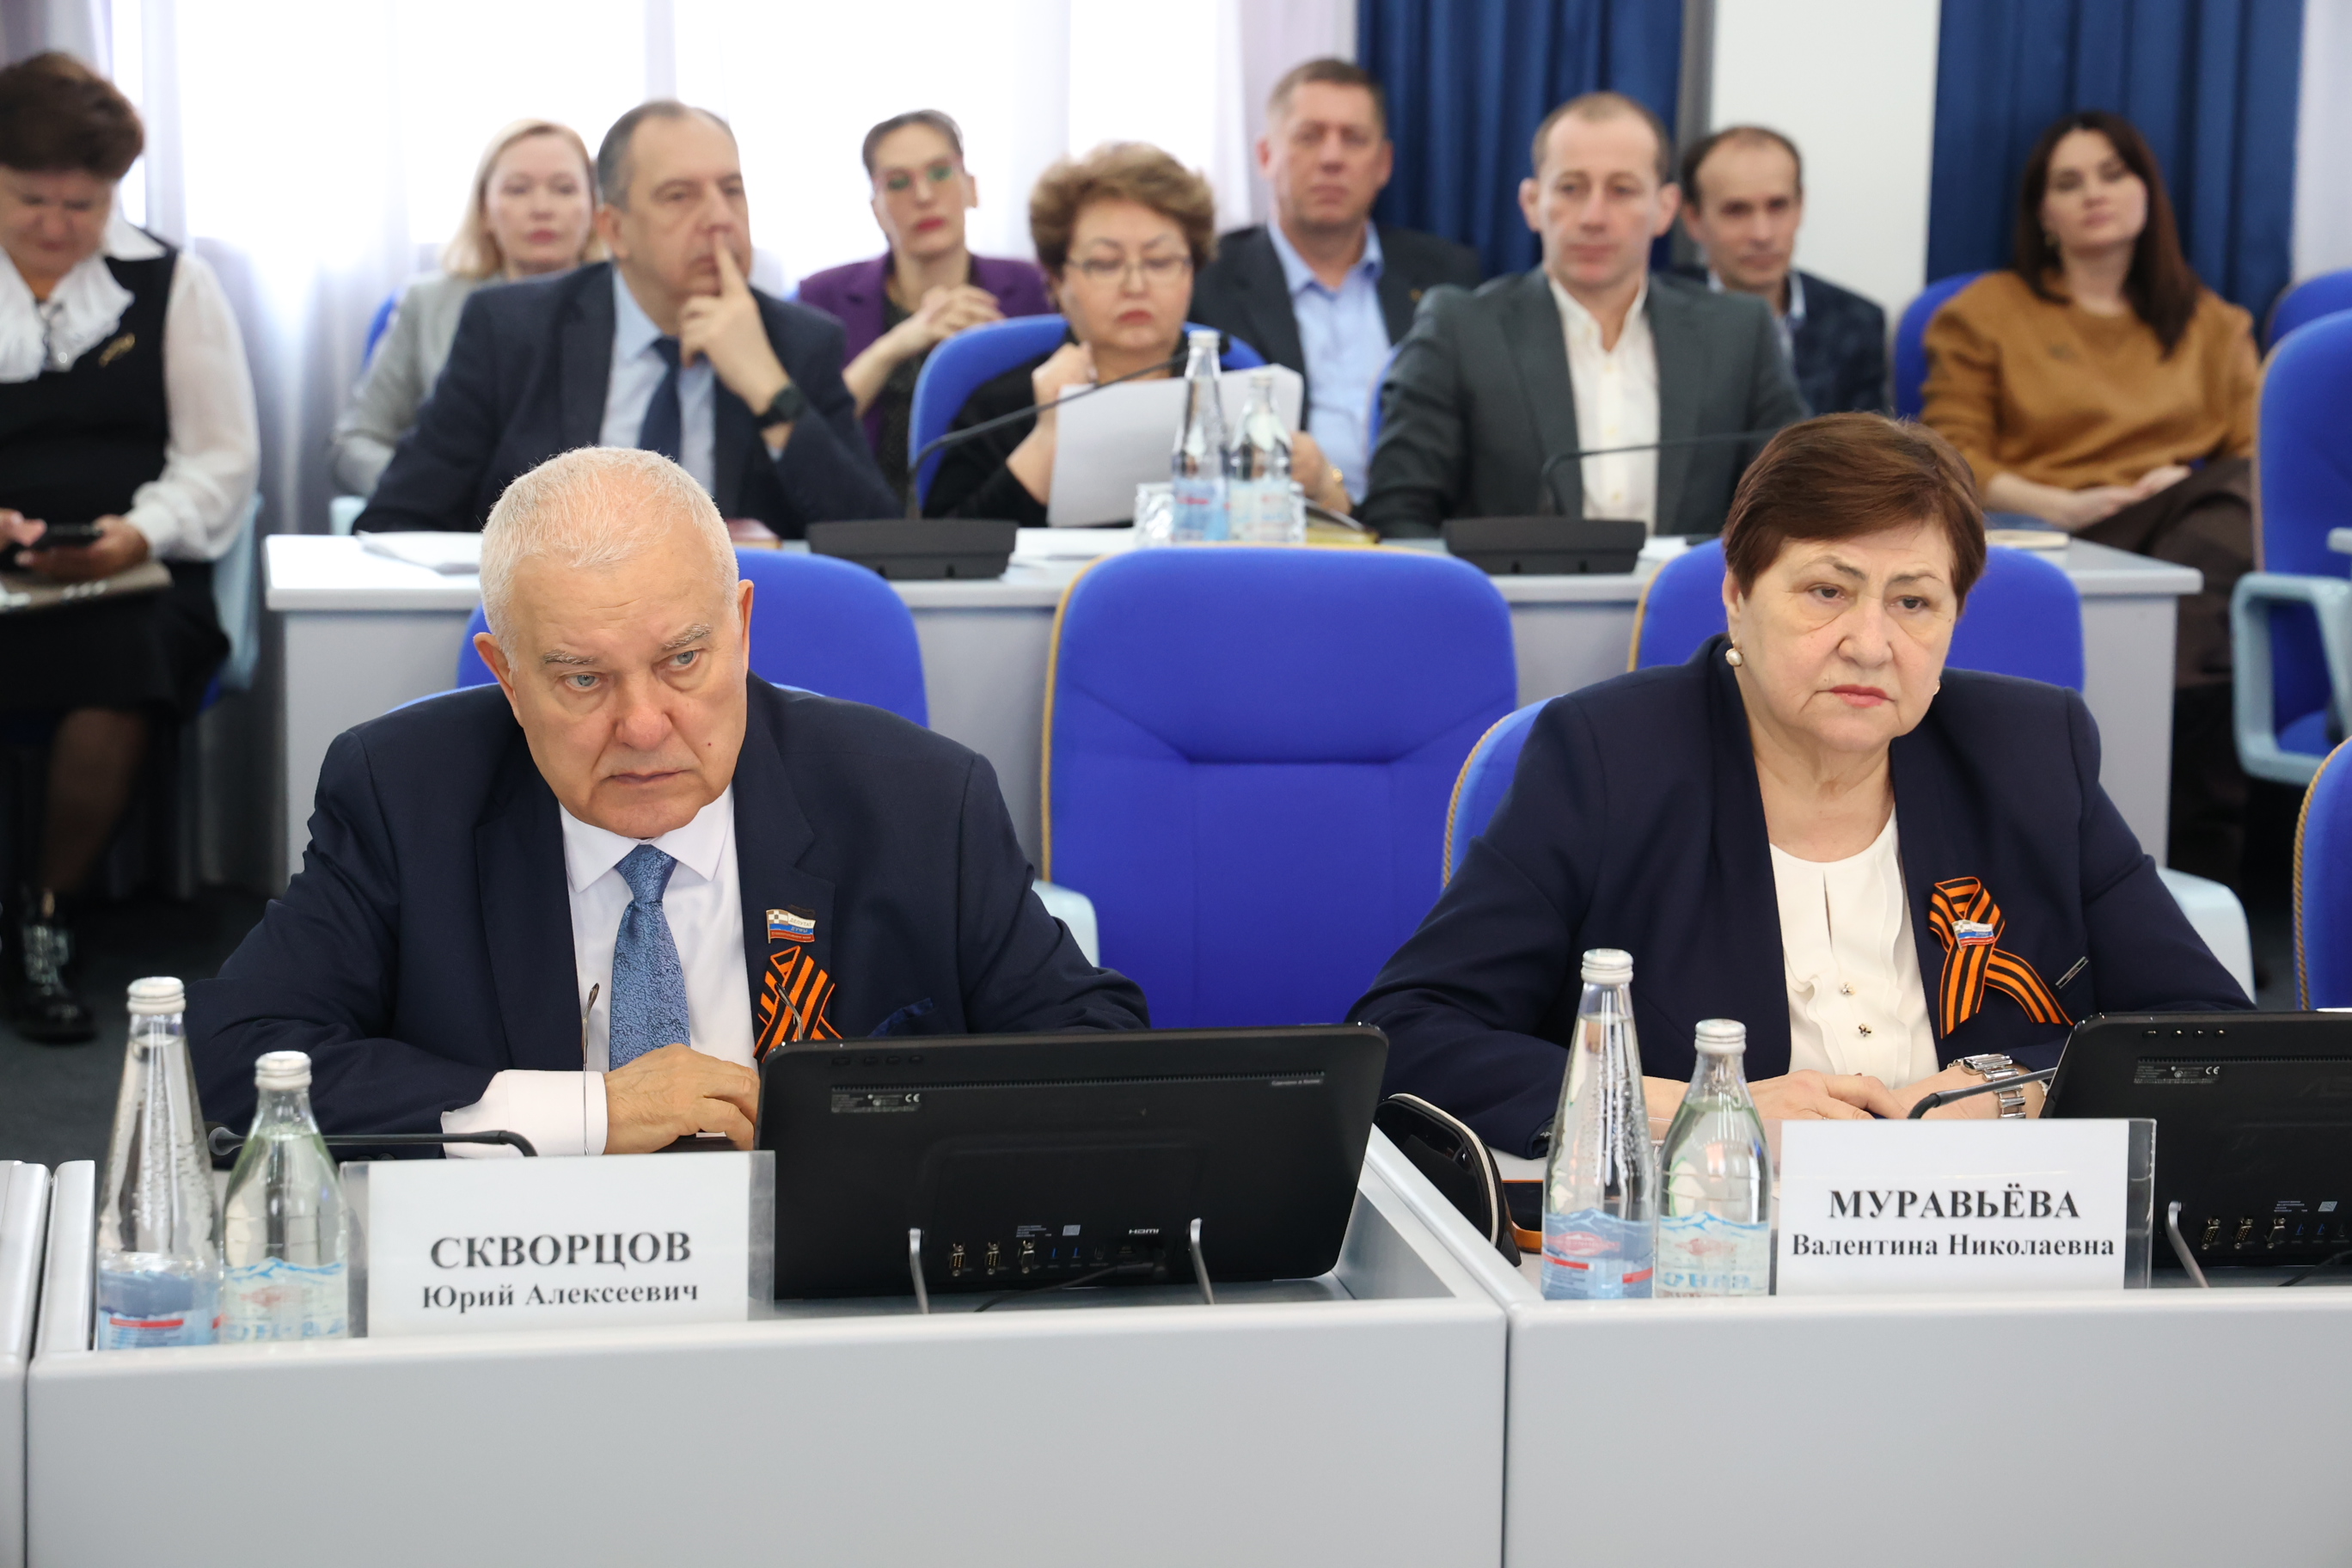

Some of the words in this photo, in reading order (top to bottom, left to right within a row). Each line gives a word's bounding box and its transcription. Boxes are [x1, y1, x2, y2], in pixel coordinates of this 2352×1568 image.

[1828, 1183, 2081, 1219] МУРАВЬЁВА
[430, 1231, 691, 1270] СКВОРЦОВ
[1792, 1234, 1939, 1256] Валентина
[1949, 1234, 2115, 1256] Николаевна
[422, 1283, 514, 1314] Юрий
[525, 1284, 699, 1305] Алексеевич
